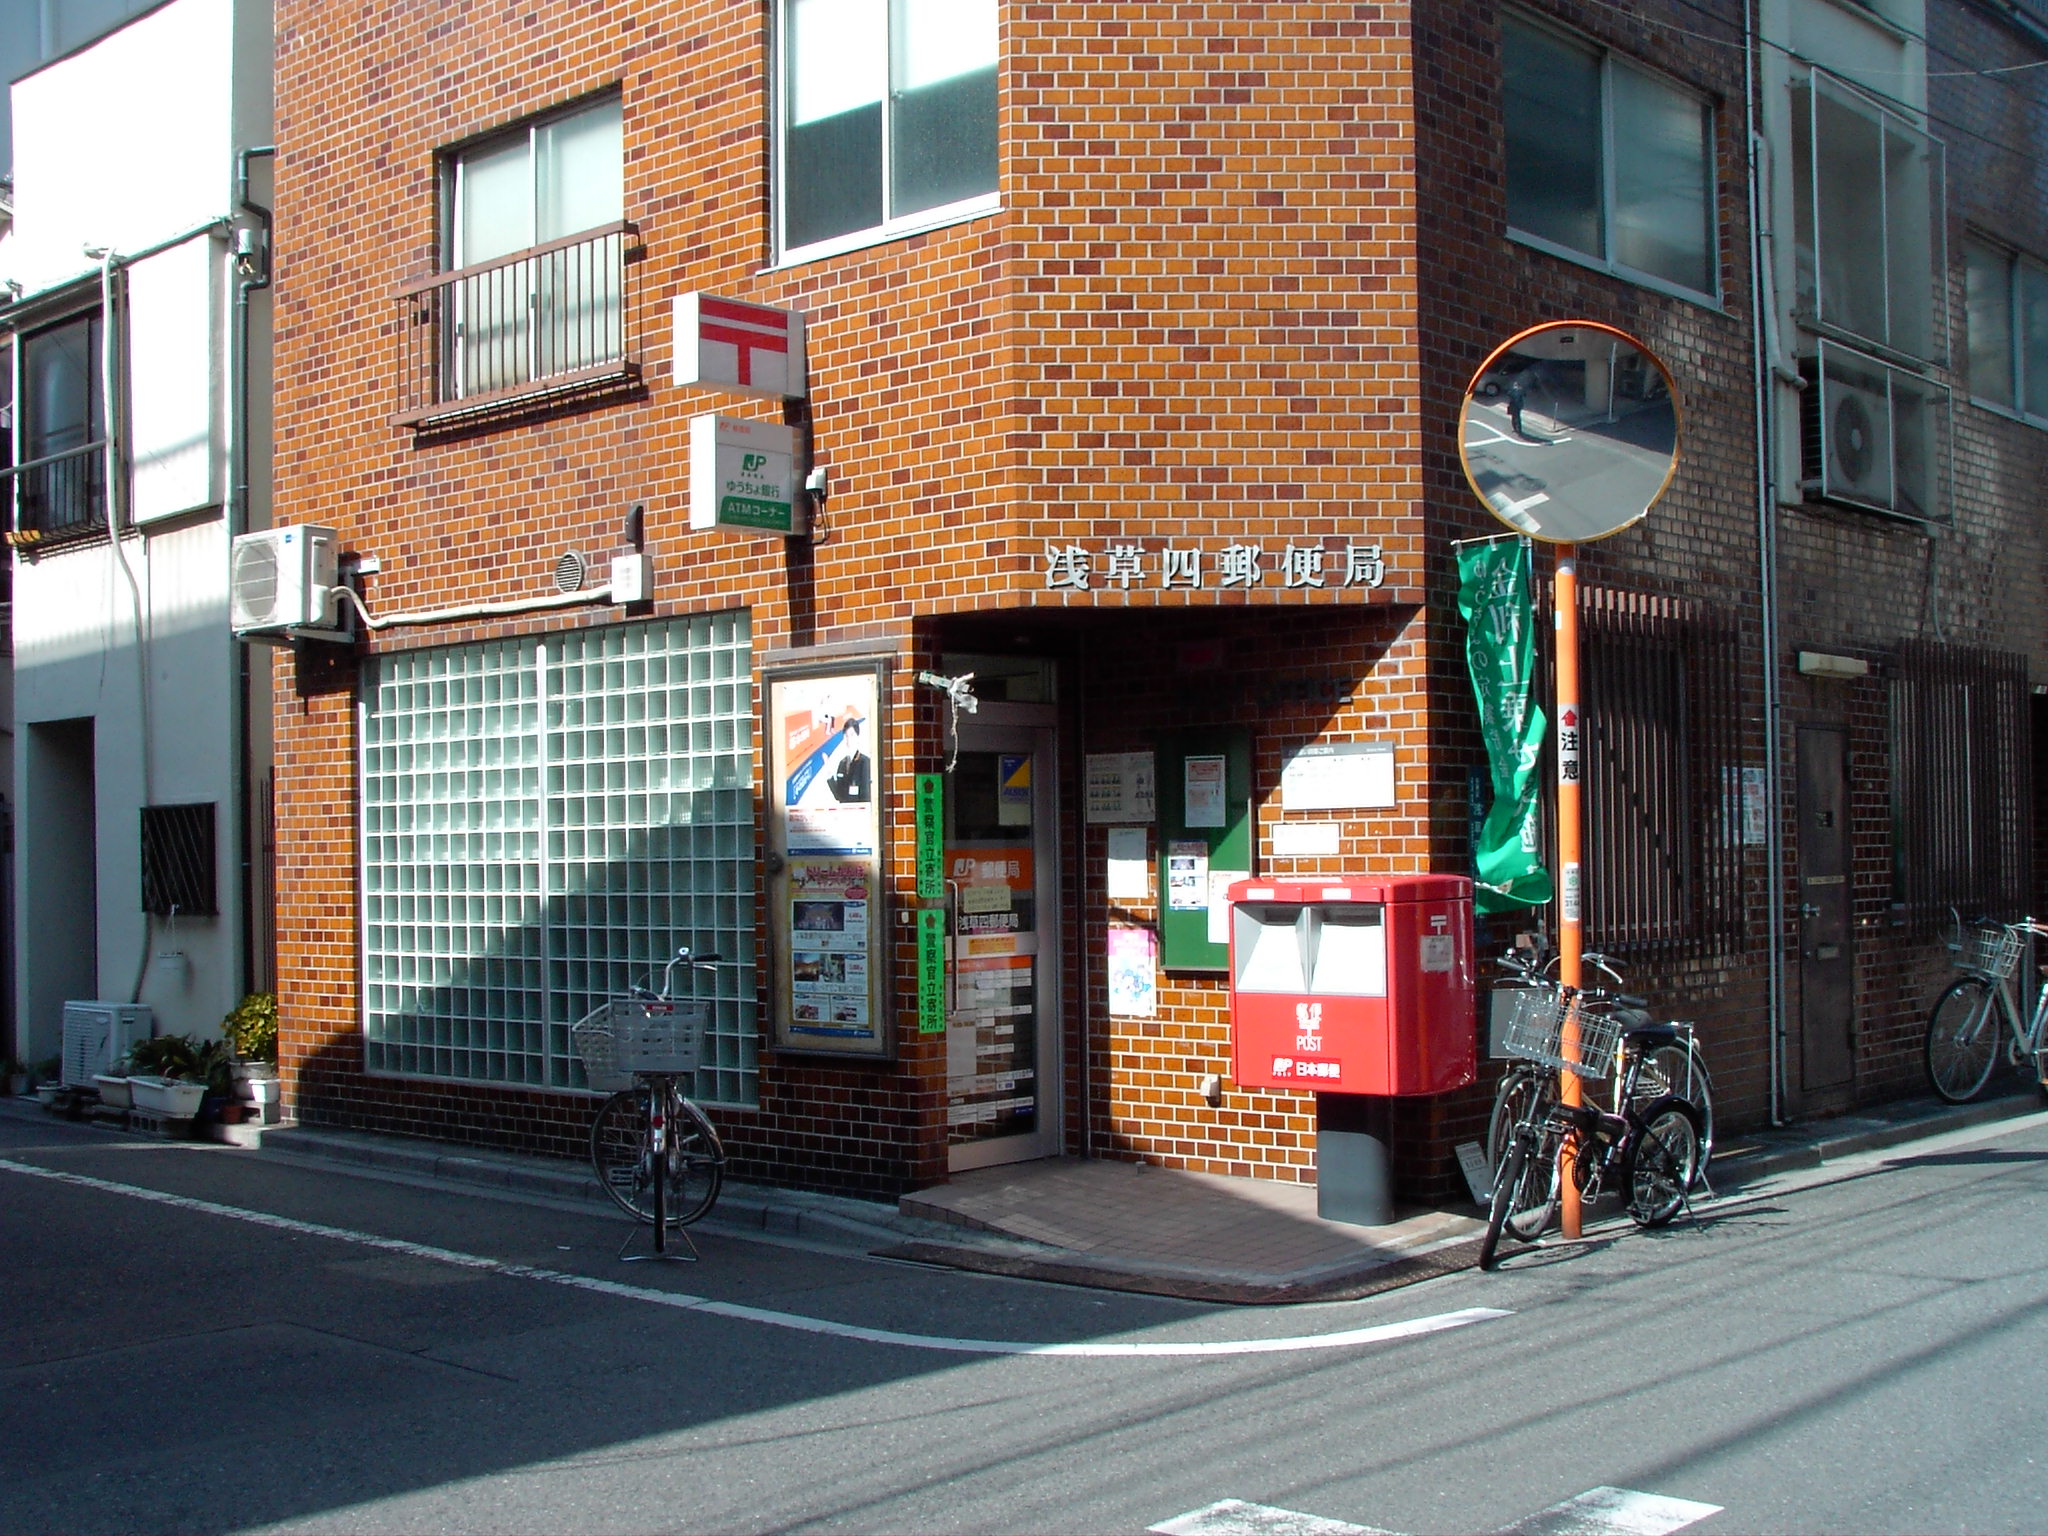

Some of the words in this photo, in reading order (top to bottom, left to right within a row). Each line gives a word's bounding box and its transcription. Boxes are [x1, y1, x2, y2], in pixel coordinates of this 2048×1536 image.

[726, 480, 780, 498] ゆうちょ銀行
[728, 502, 785, 518] ATMコーナー
[1044, 543, 1387, 590] 浅草四郵便局
[1561, 731, 1579, 781] 注意
[923, 797, 936, 895] 警察官立寄所
[958, 912, 1019, 931] 浅草四郵便局
[925, 933, 938, 1030] 警察官立寄所
[1296, 1035, 1322, 1052] POST
